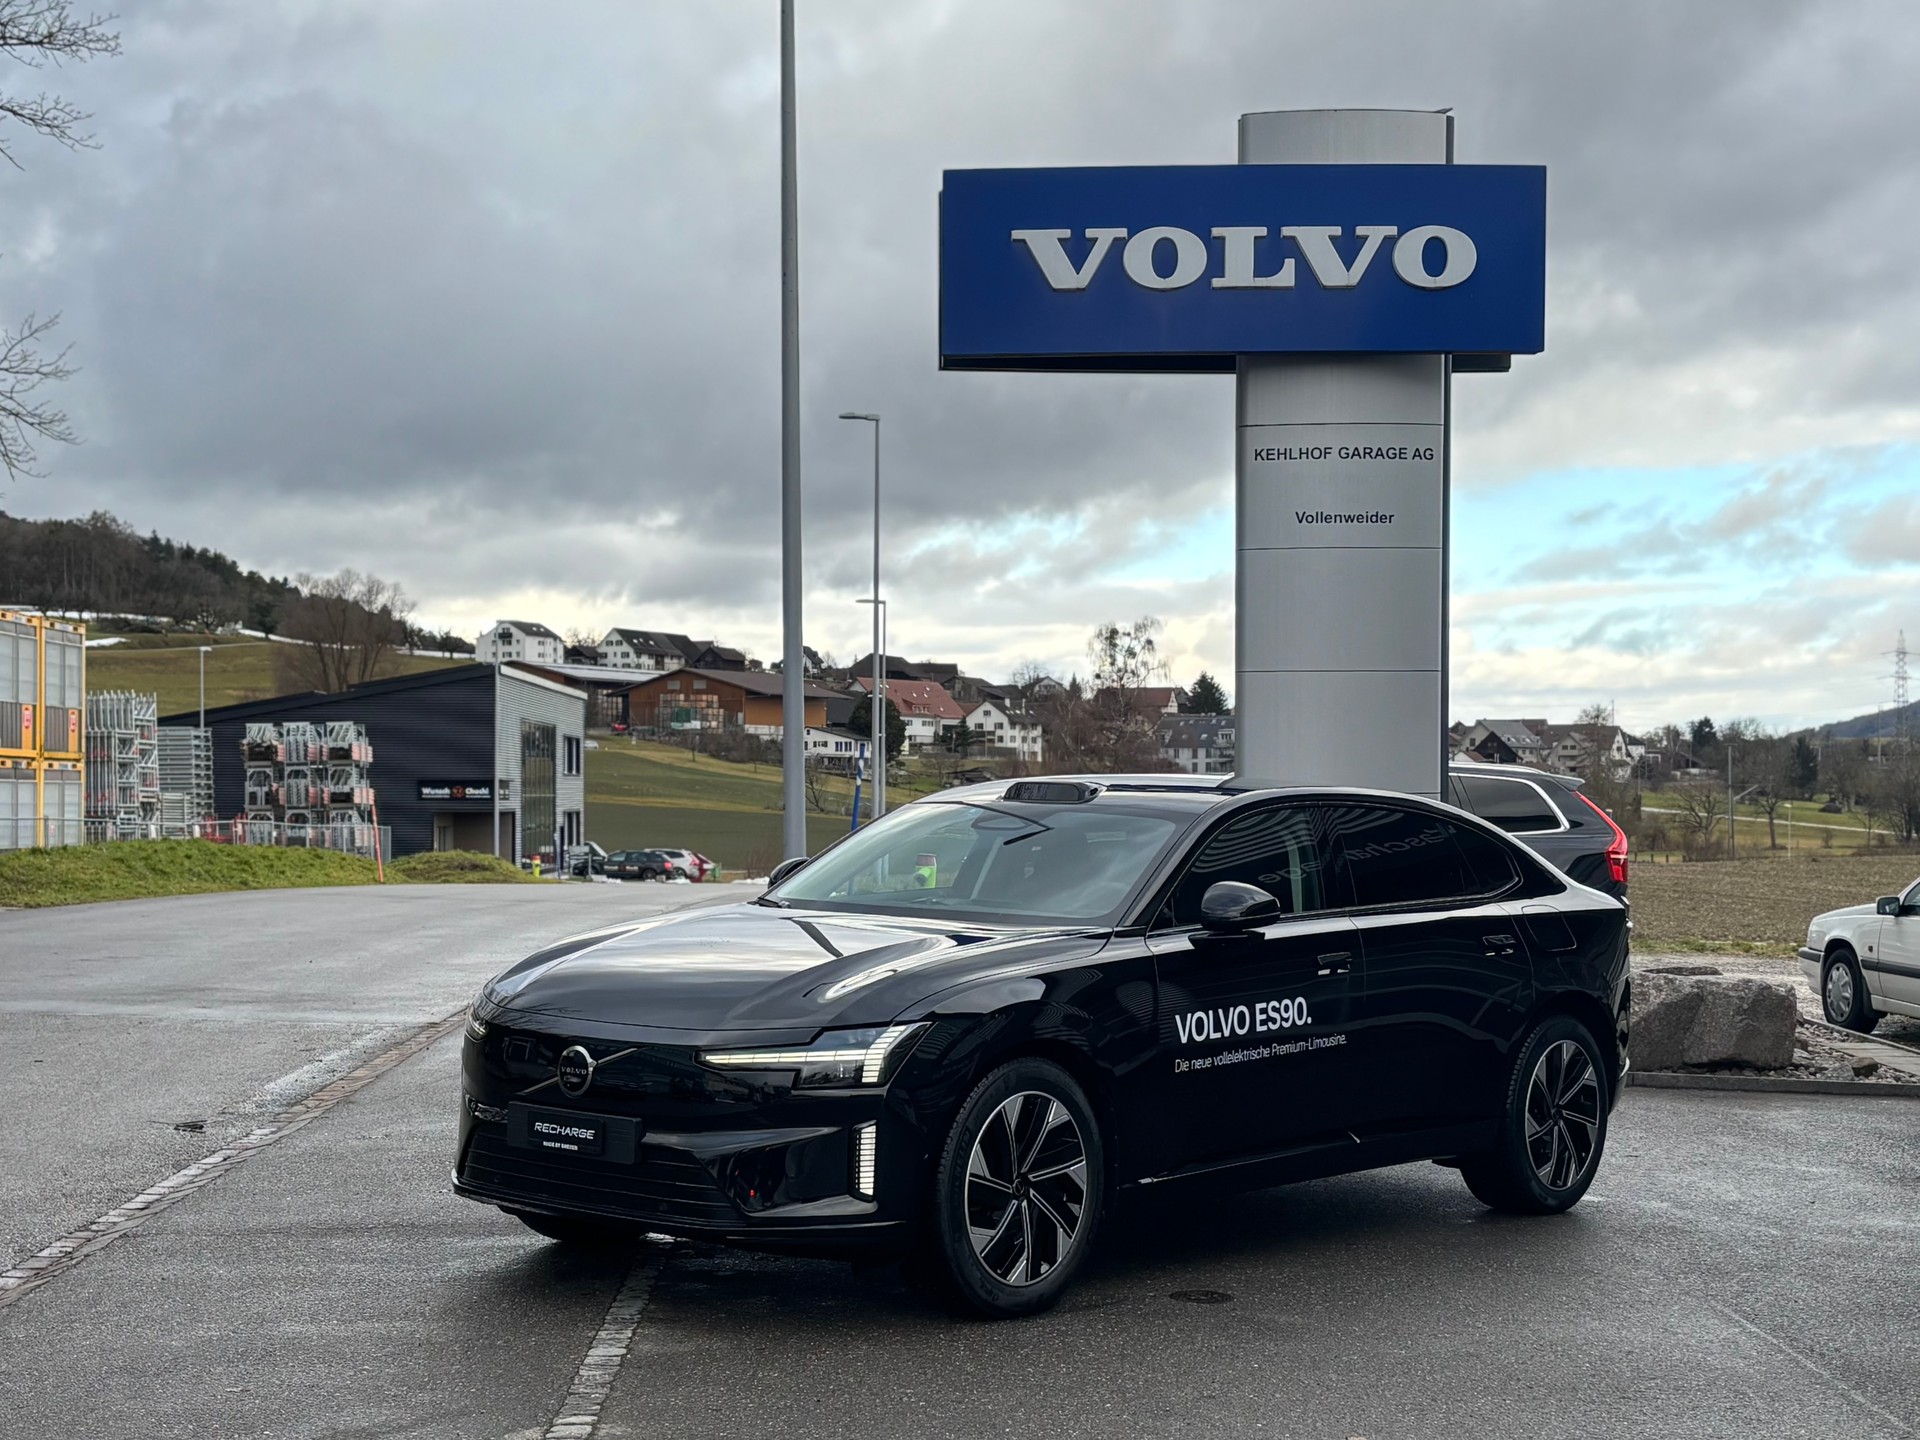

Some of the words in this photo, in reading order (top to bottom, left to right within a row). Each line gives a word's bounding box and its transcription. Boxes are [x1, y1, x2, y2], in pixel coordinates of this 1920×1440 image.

[1010, 224, 1478, 291] VOLVO
[1254, 447, 1333, 461] KEHLHOF
[1338, 446, 1408, 460] GARAGE
[1411, 447, 1434, 460] AG
[1295, 511, 1395, 524] Vollenweider
[1175, 1005, 1250, 1044] VOLVO
[1255, 996, 1313, 1032] ES90.
[1174, 1058, 1190, 1073] Die
[1191, 1057, 1212, 1070] neue
[1213, 1045, 1270, 1066] vollelektrische
[561, 1066, 587, 1075] VOLVO
[534, 1122, 596, 1140] RECHARGE
